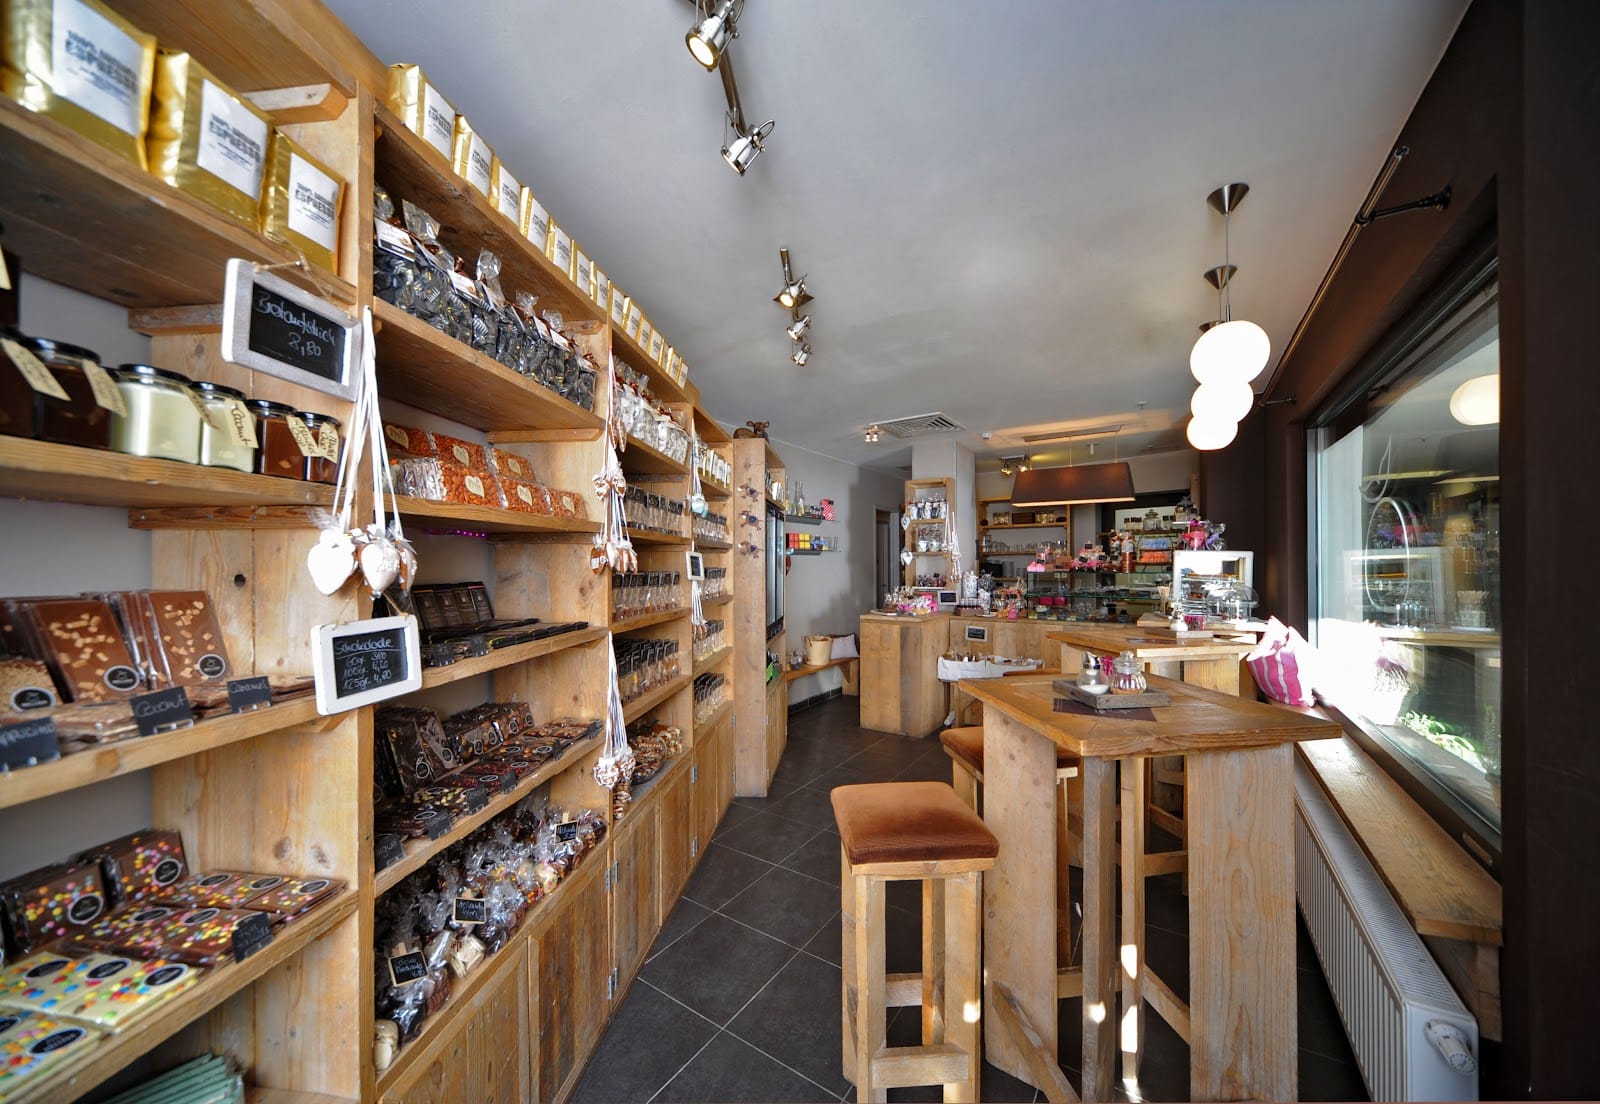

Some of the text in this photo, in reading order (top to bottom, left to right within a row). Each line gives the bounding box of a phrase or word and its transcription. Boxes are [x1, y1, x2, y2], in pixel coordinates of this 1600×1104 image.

[209, 121, 261, 163] ESPRESSO
[295, 189, 335, 220] ESPRESSO
[334, 637, 395, 655] Schokolade
[229, 681, 268, 694] Caramel
